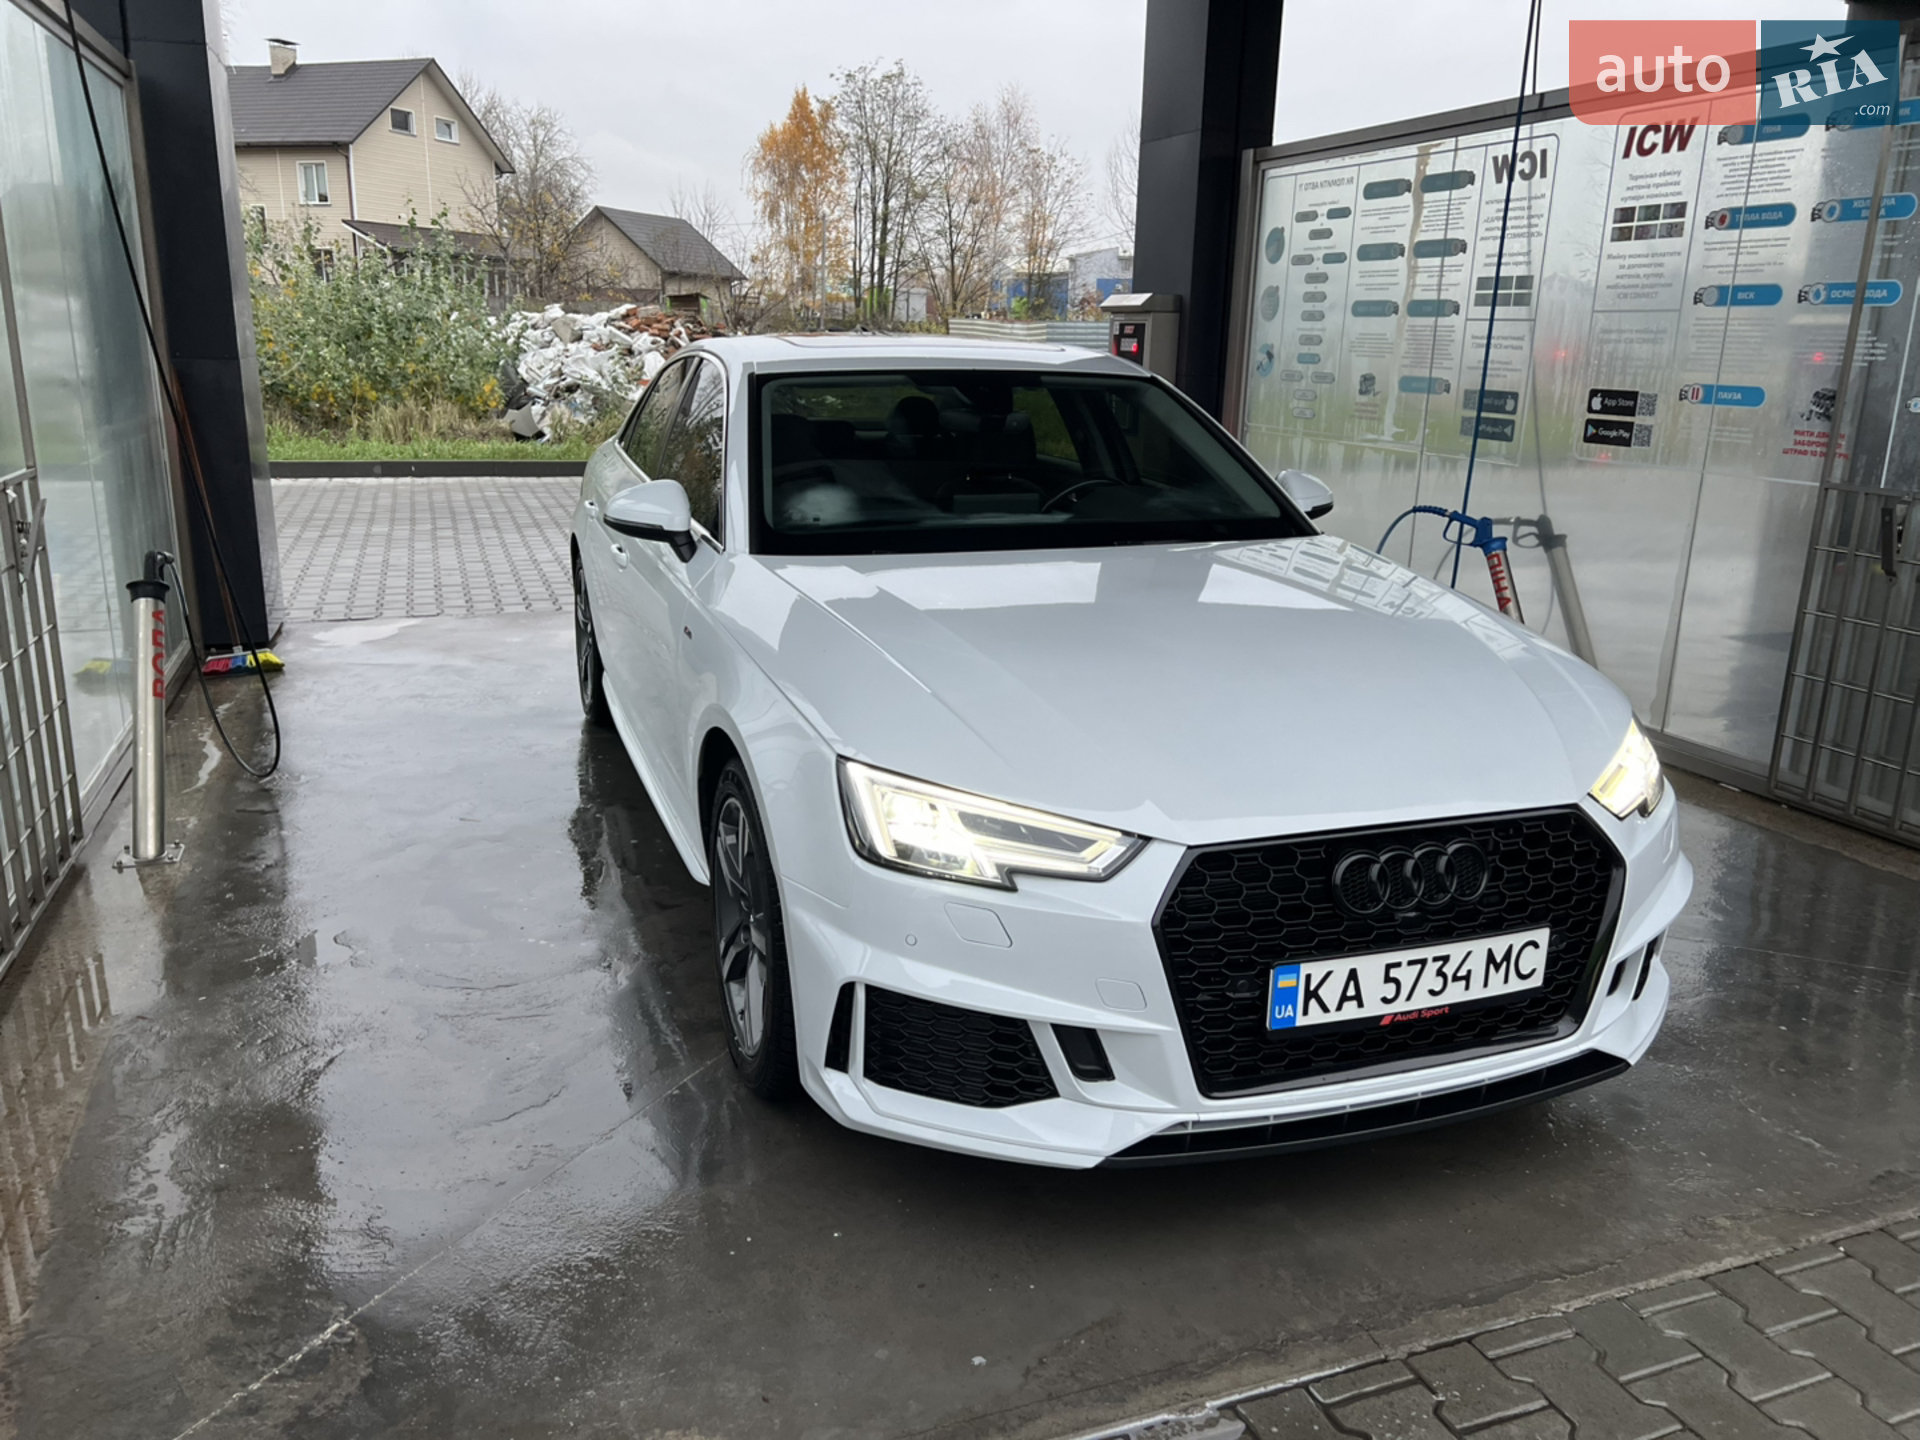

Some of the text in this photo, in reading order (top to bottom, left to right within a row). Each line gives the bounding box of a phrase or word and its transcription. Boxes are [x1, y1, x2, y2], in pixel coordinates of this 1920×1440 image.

[1622, 116, 1700, 160] ICW
[1603, 397, 1635, 407] App Store
[1598, 427, 1631, 439] Google Play
[1302, 939, 1541, 1017] KA 5734 MC
[1275, 1003, 1294, 1019] UA
[1394, 1006, 1450, 1023] Audi Sport
